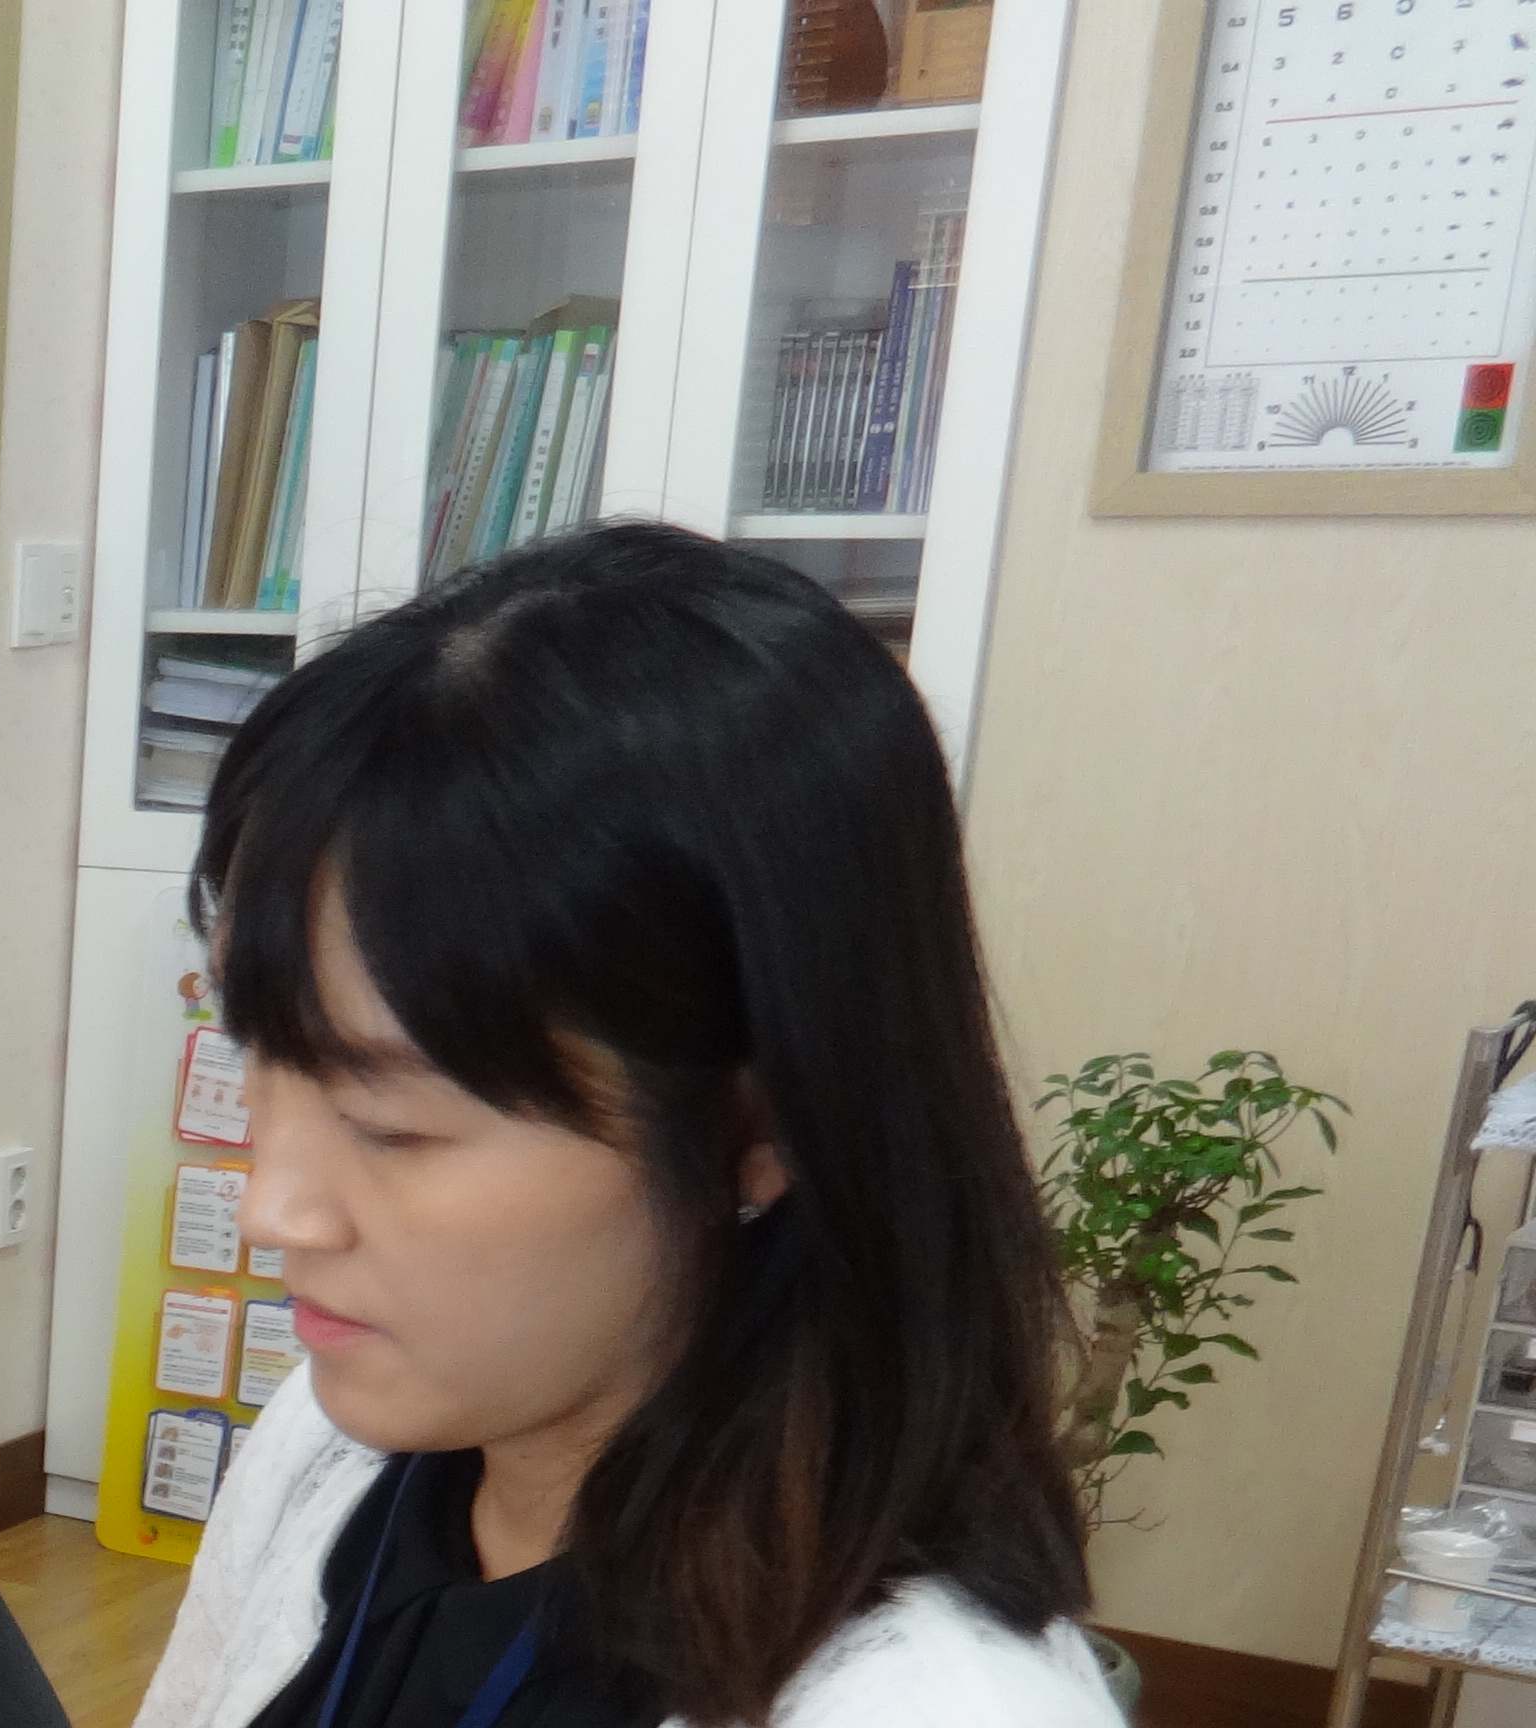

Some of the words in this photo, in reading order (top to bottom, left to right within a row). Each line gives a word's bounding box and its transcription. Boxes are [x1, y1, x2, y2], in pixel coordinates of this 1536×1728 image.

[1279, 7, 1296, 27] 5
[1337, 3, 1354, 21] 6
[1273, 56, 1286, 70] 3
[1332, 51, 1344, 65] 2
